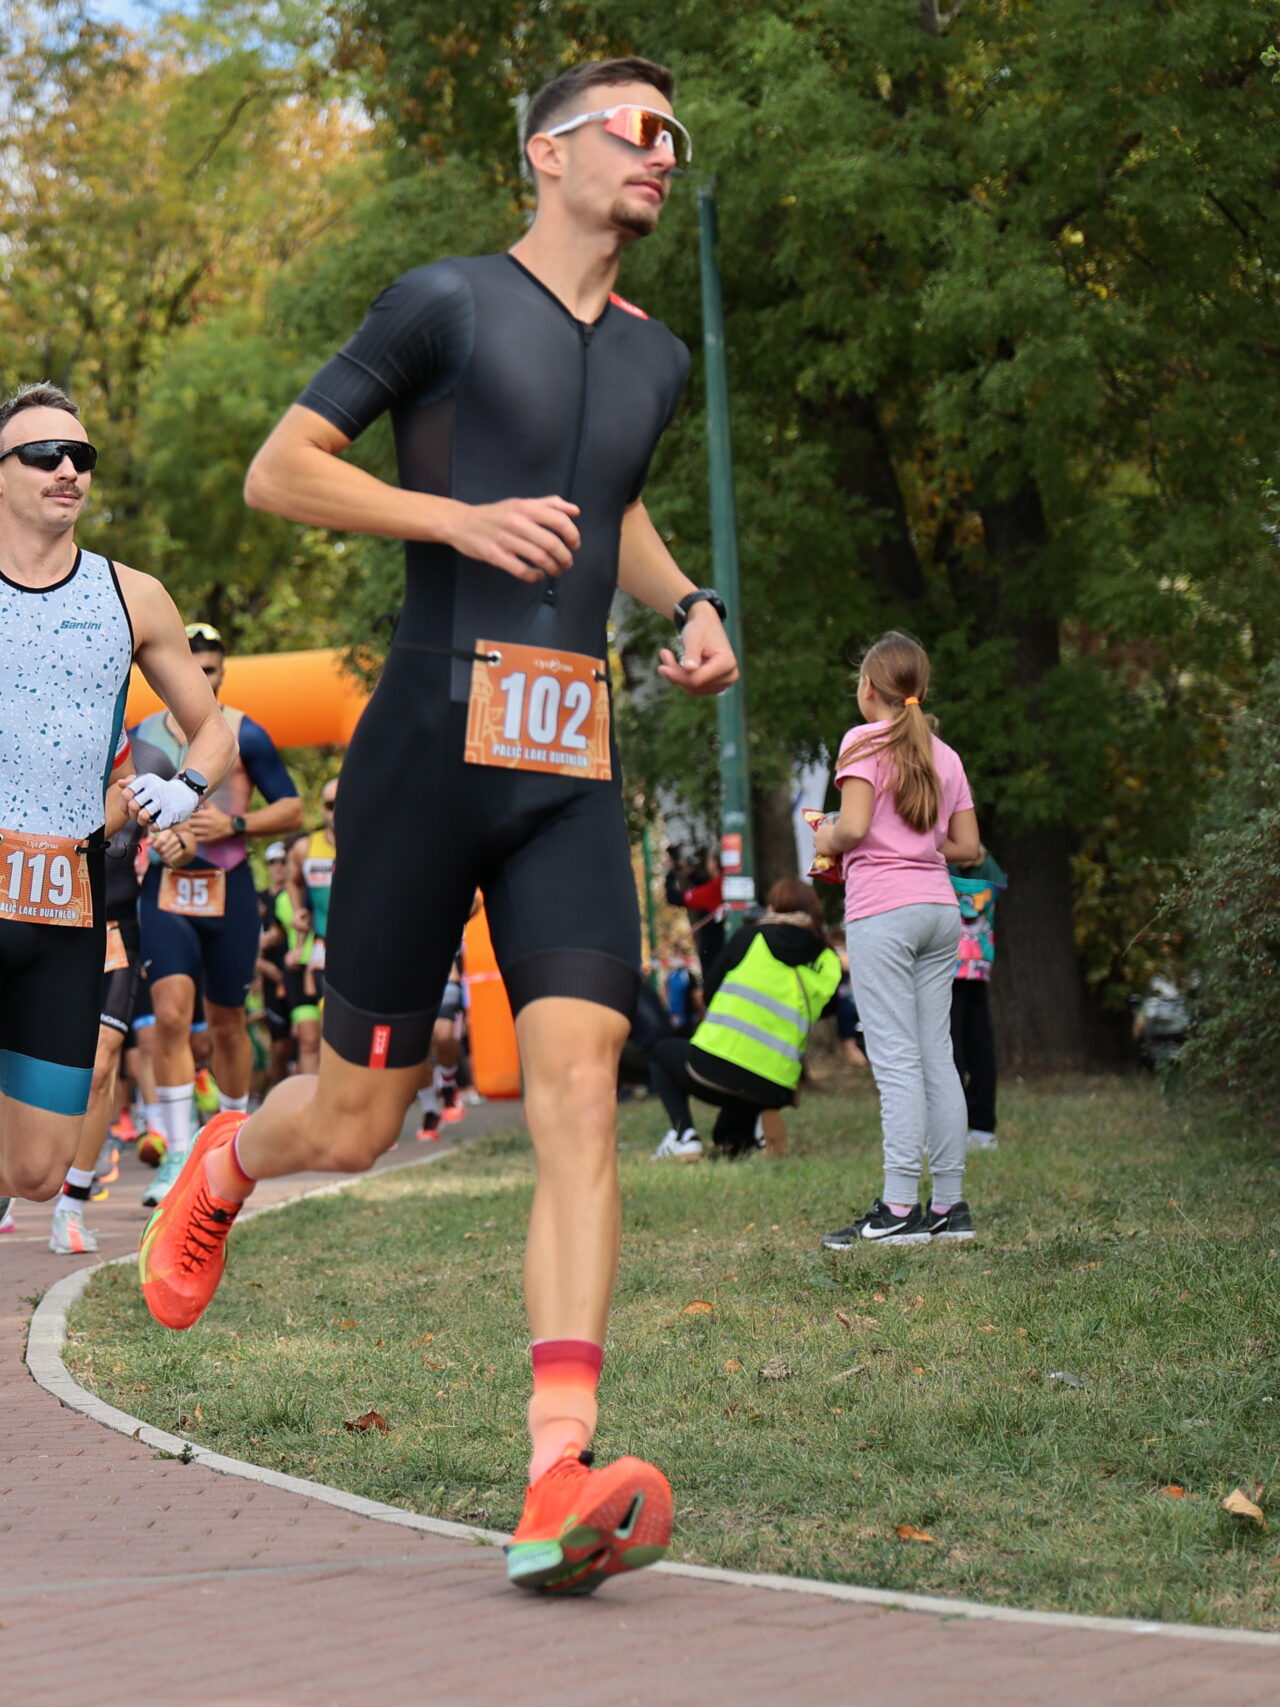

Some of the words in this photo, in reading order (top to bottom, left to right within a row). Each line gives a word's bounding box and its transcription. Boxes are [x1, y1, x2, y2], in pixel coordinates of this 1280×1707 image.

[60, 620, 102, 630] Santini
[500, 671, 592, 750] 102
[6, 850, 73, 906] 119
[176, 877, 209, 905] 95
[19, 905, 37, 916] LAKE
[39, 907, 77, 920] DUATHLON
